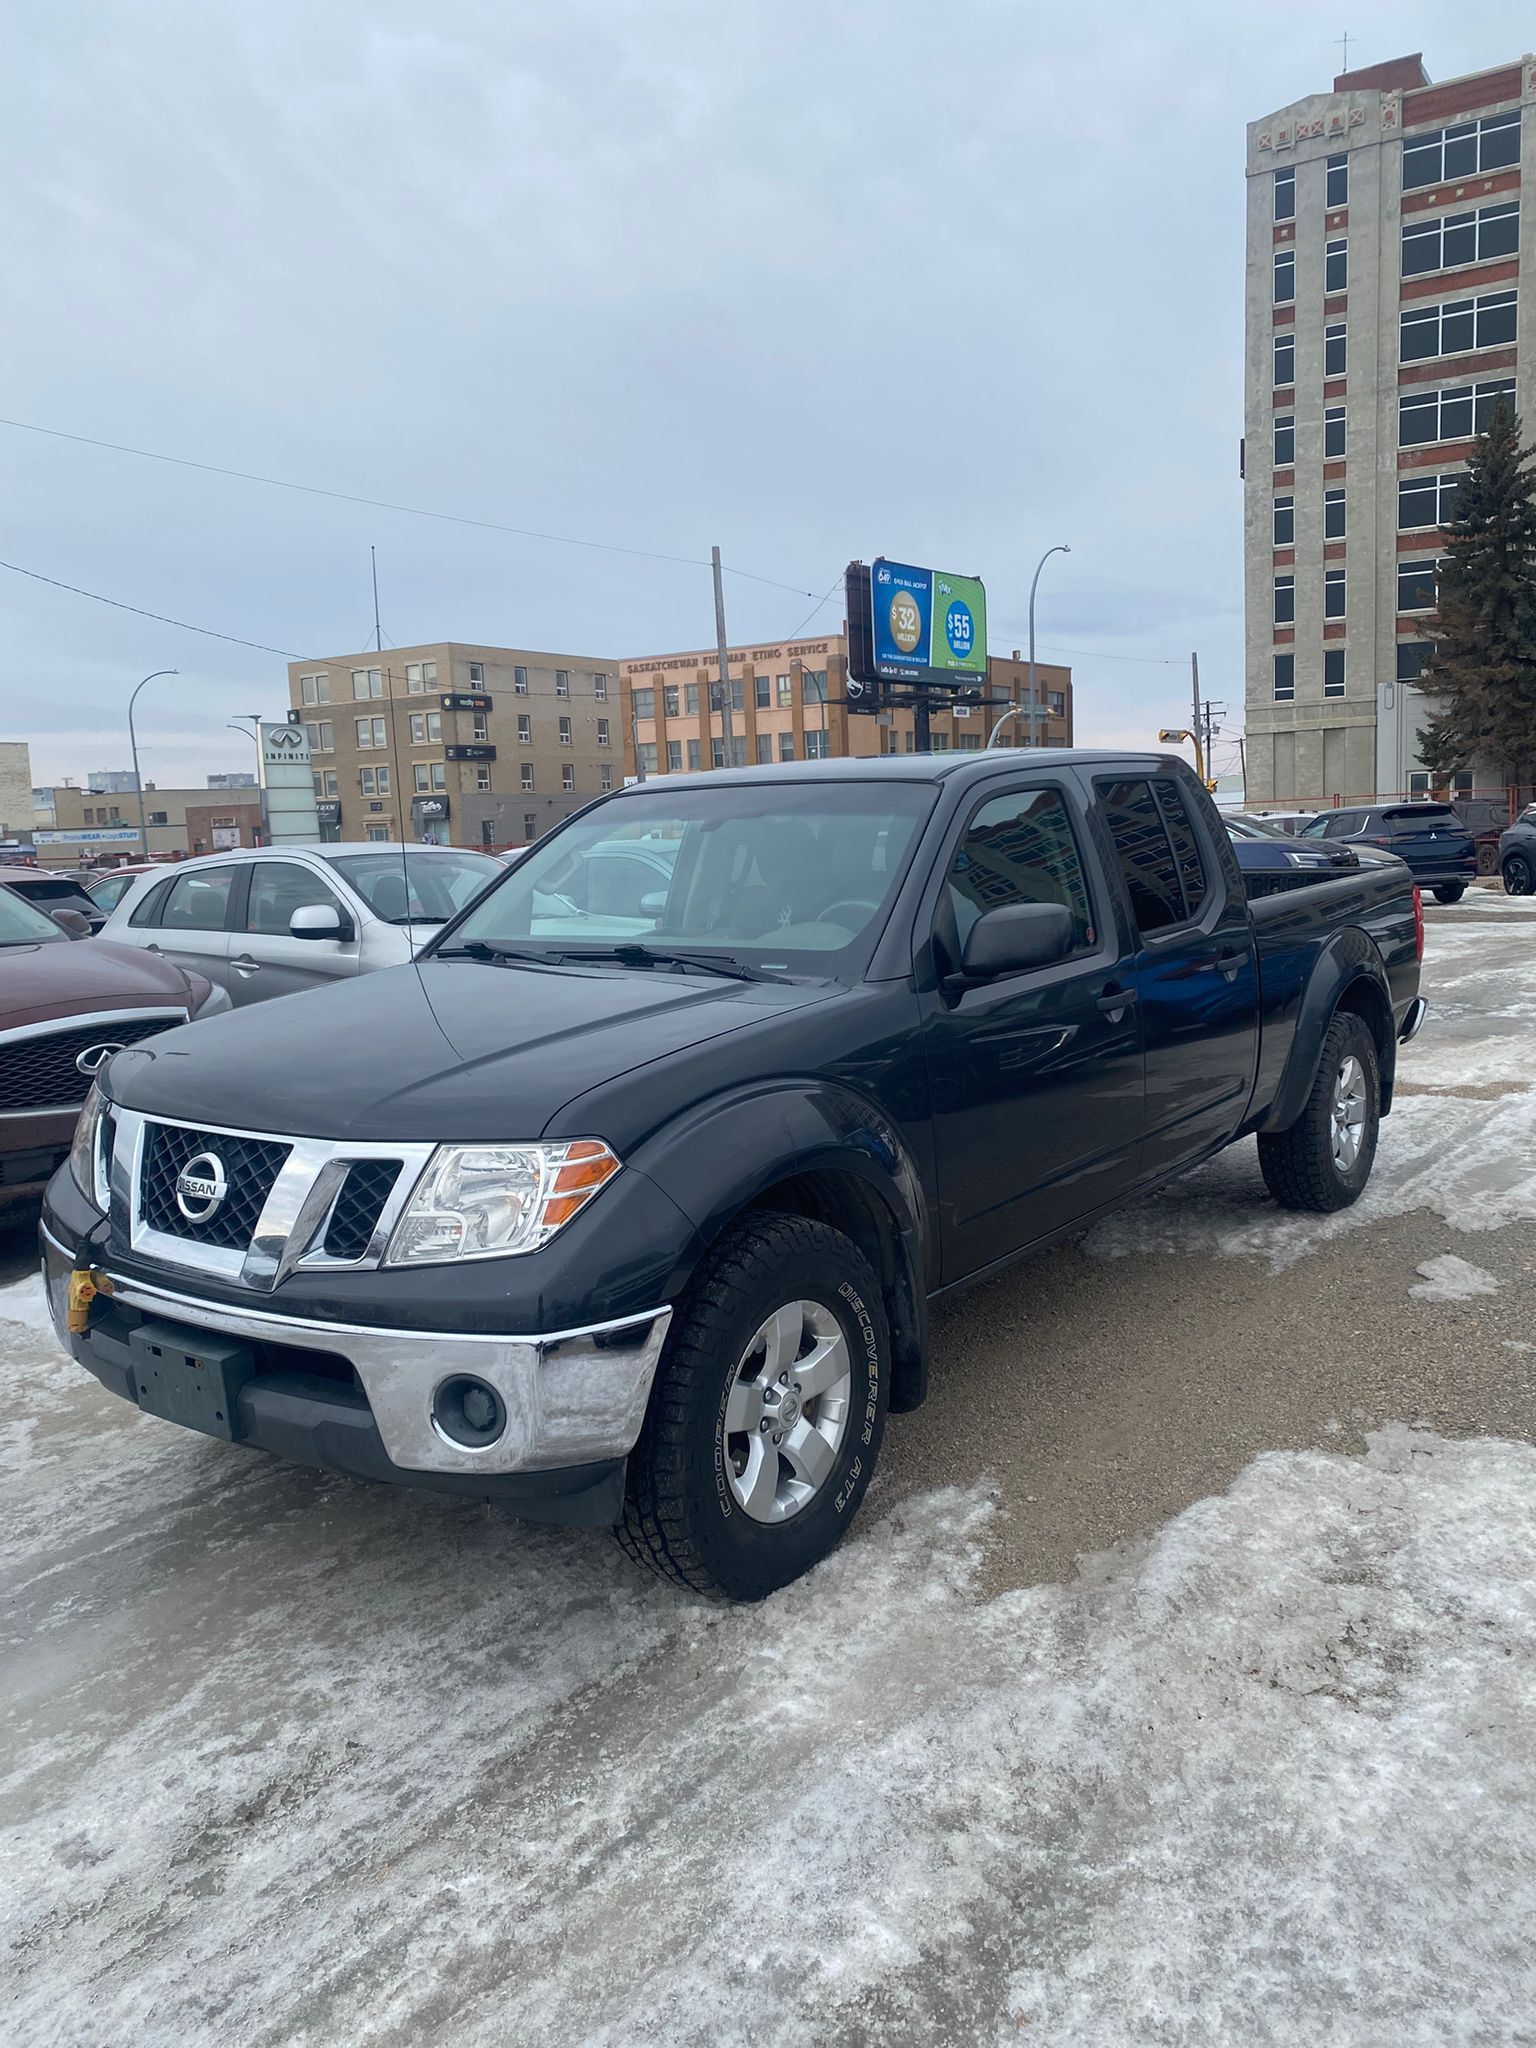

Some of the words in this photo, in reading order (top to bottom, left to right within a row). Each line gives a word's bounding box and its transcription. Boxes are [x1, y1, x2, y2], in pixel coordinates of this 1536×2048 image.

[897, 632, 916, 643] MILLION
[953, 640, 970, 650] MILLION
[627, 657, 698, 674] SASKATCHEWAN
[787, 643, 829, 657] SERVICE
[180, 1177, 217, 1196] NISSAN
[838, 1281, 878, 1445] DISCOVERER
[714, 1363, 735, 1518] COOPER
